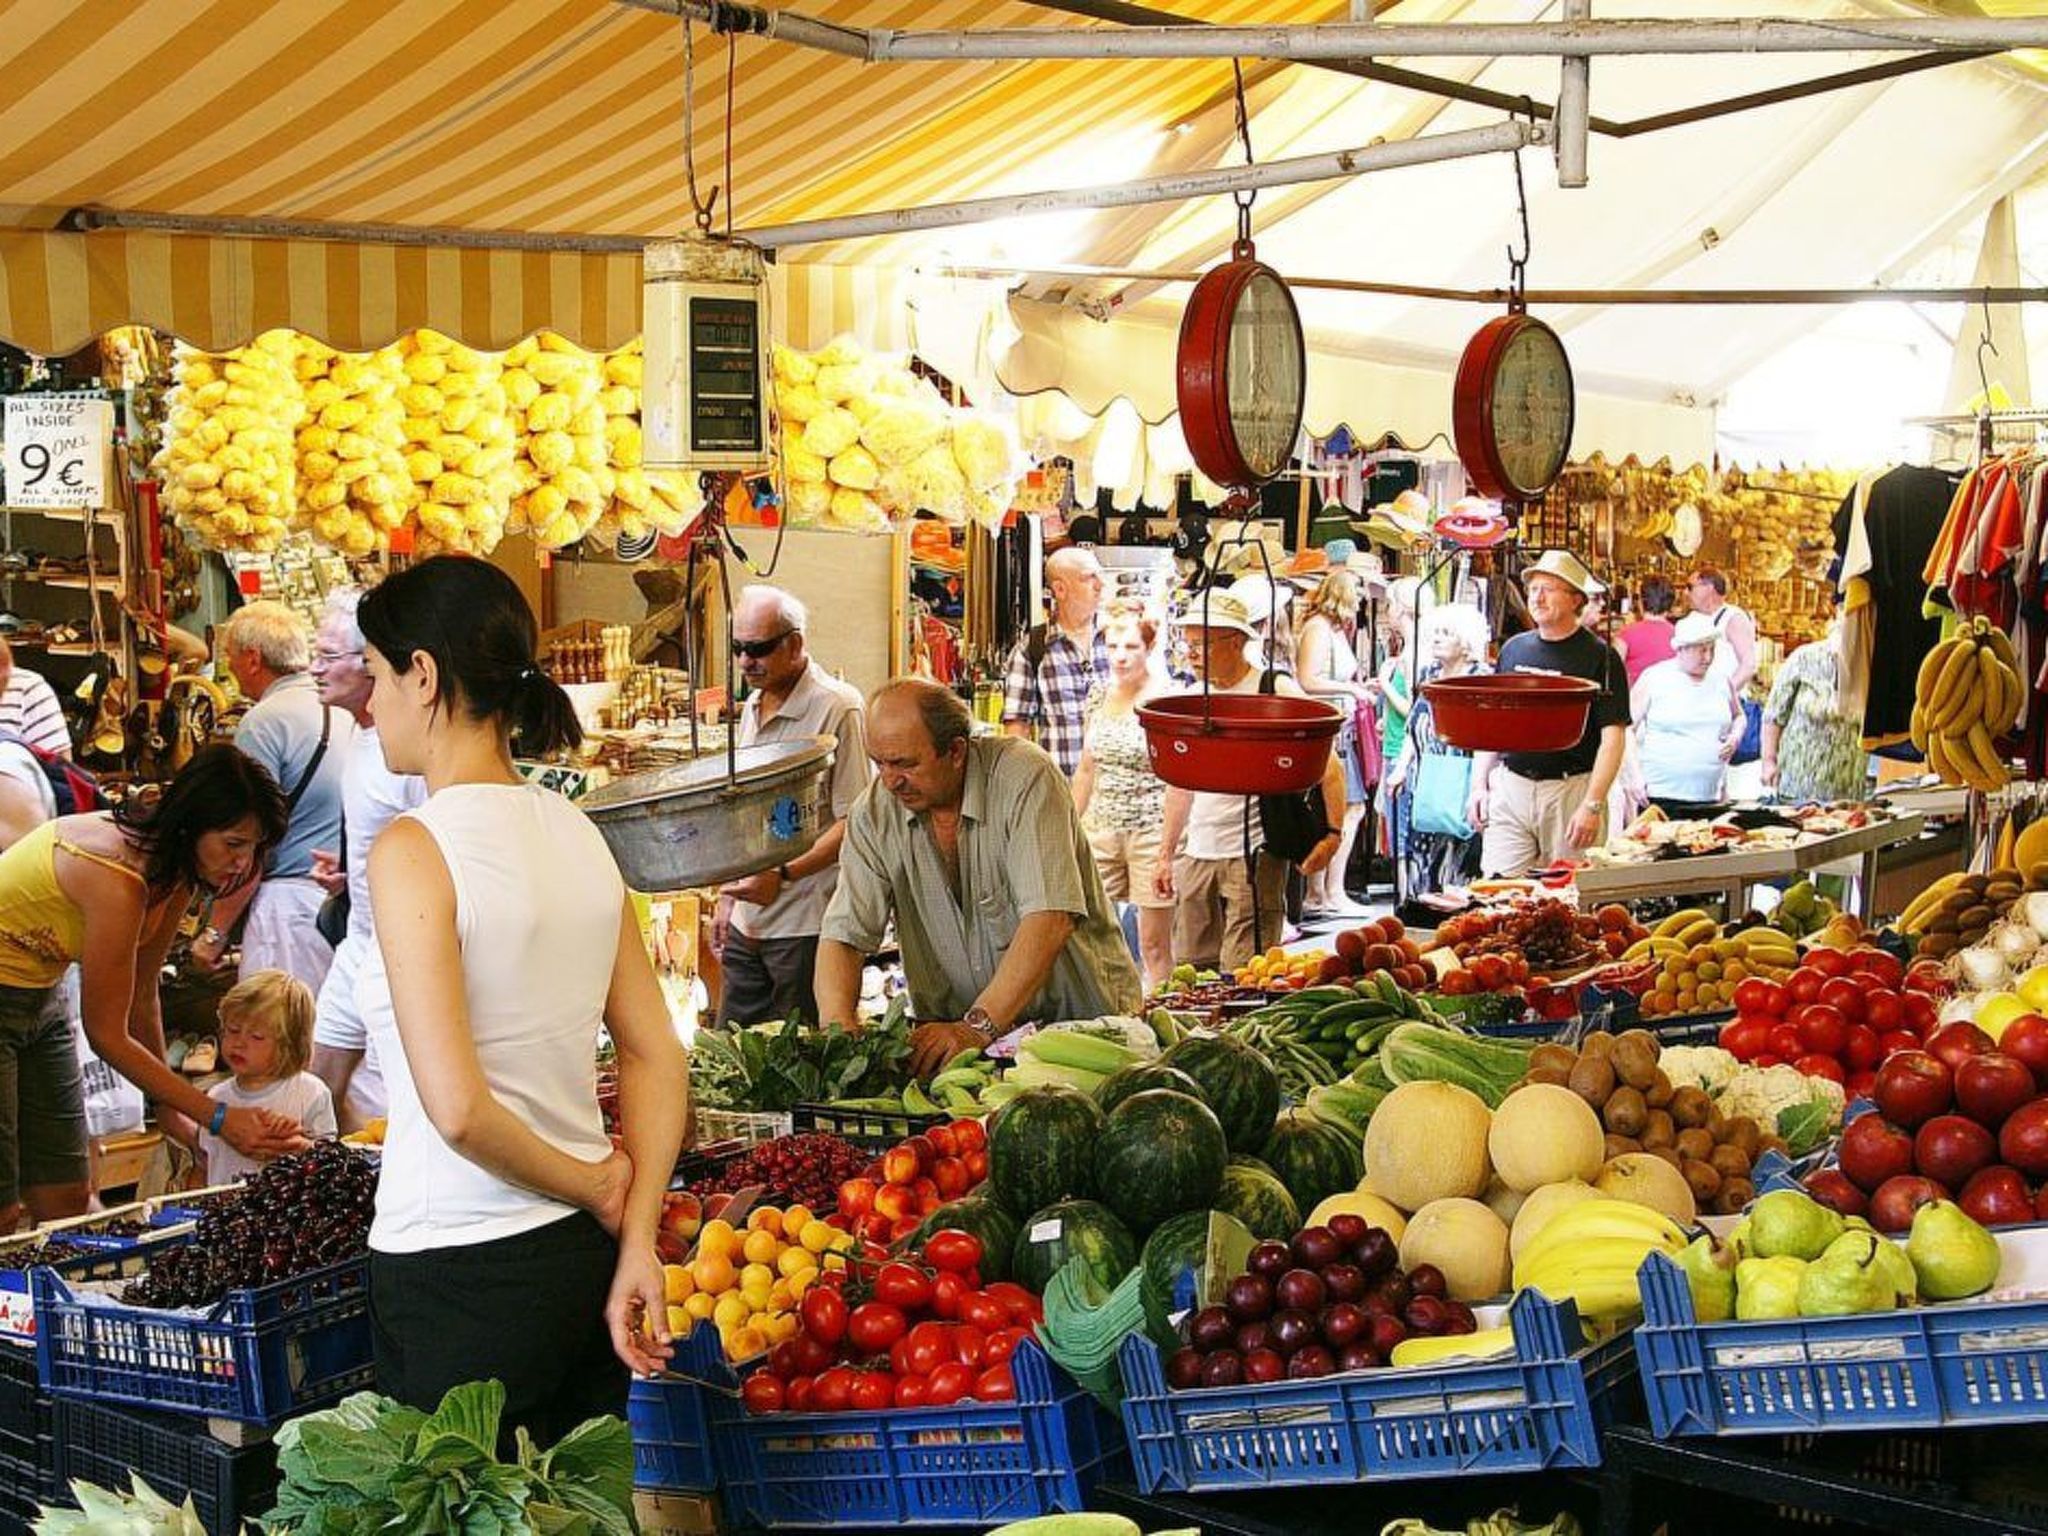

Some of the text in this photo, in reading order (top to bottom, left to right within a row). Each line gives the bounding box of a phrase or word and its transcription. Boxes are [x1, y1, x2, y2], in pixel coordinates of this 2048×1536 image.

[10, 401, 86, 414] ALL SIZES
[25, 415, 75, 427] INSIDE
